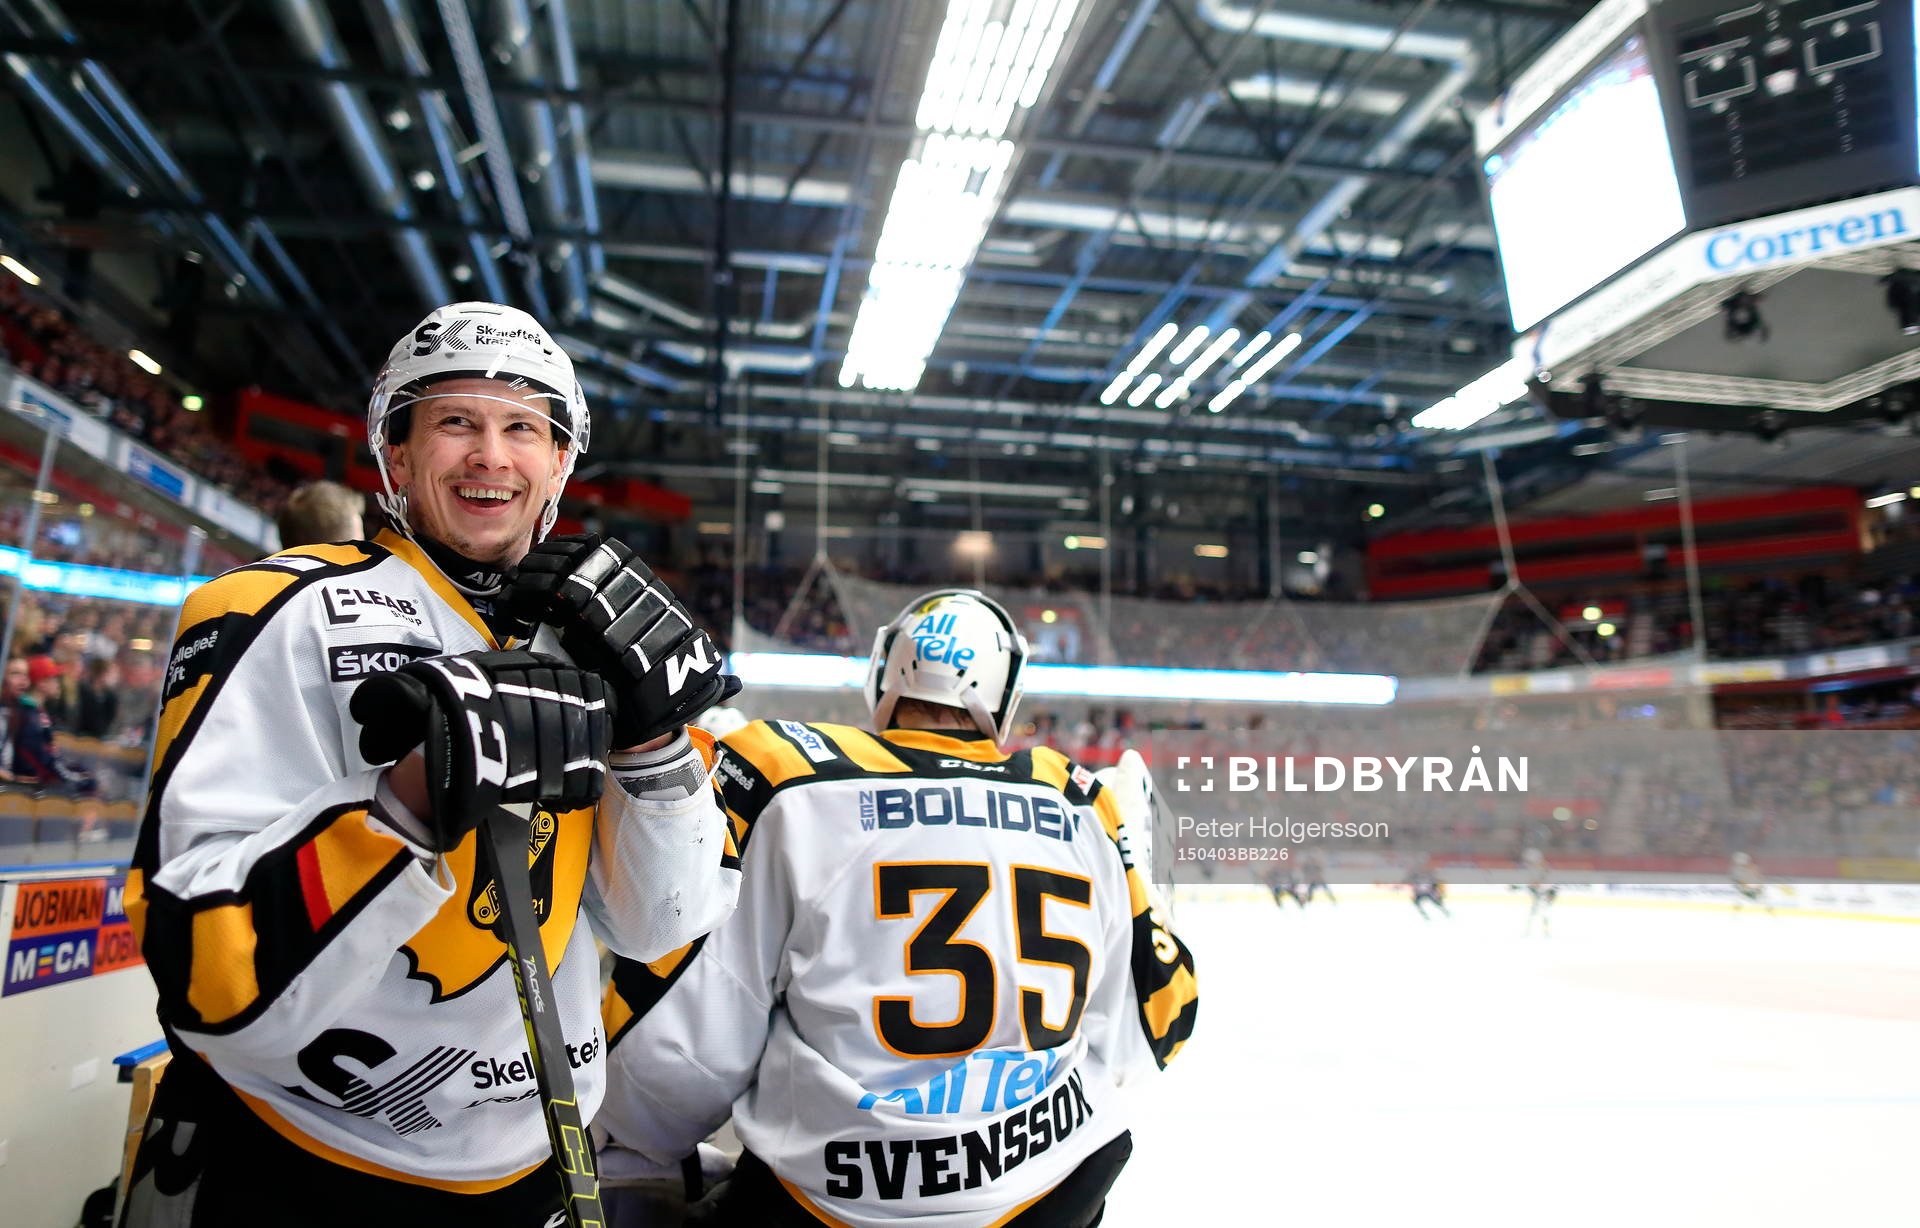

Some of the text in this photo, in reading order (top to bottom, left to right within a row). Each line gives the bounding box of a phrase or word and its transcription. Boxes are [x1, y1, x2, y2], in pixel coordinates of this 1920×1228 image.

[1706, 206, 1909, 273] Corren
[912, 614, 958, 636] All
[336, 650, 421, 676] ŠKOD
[912, 635, 975, 671] Tele
[859, 790, 875, 832] NEW
[14, 886, 102, 930] JOBMAN
[873, 861, 1091, 1060] 35
[470, 1026, 600, 1090] Skelteå
[824, 1067, 1093, 1200] SVENSSON
